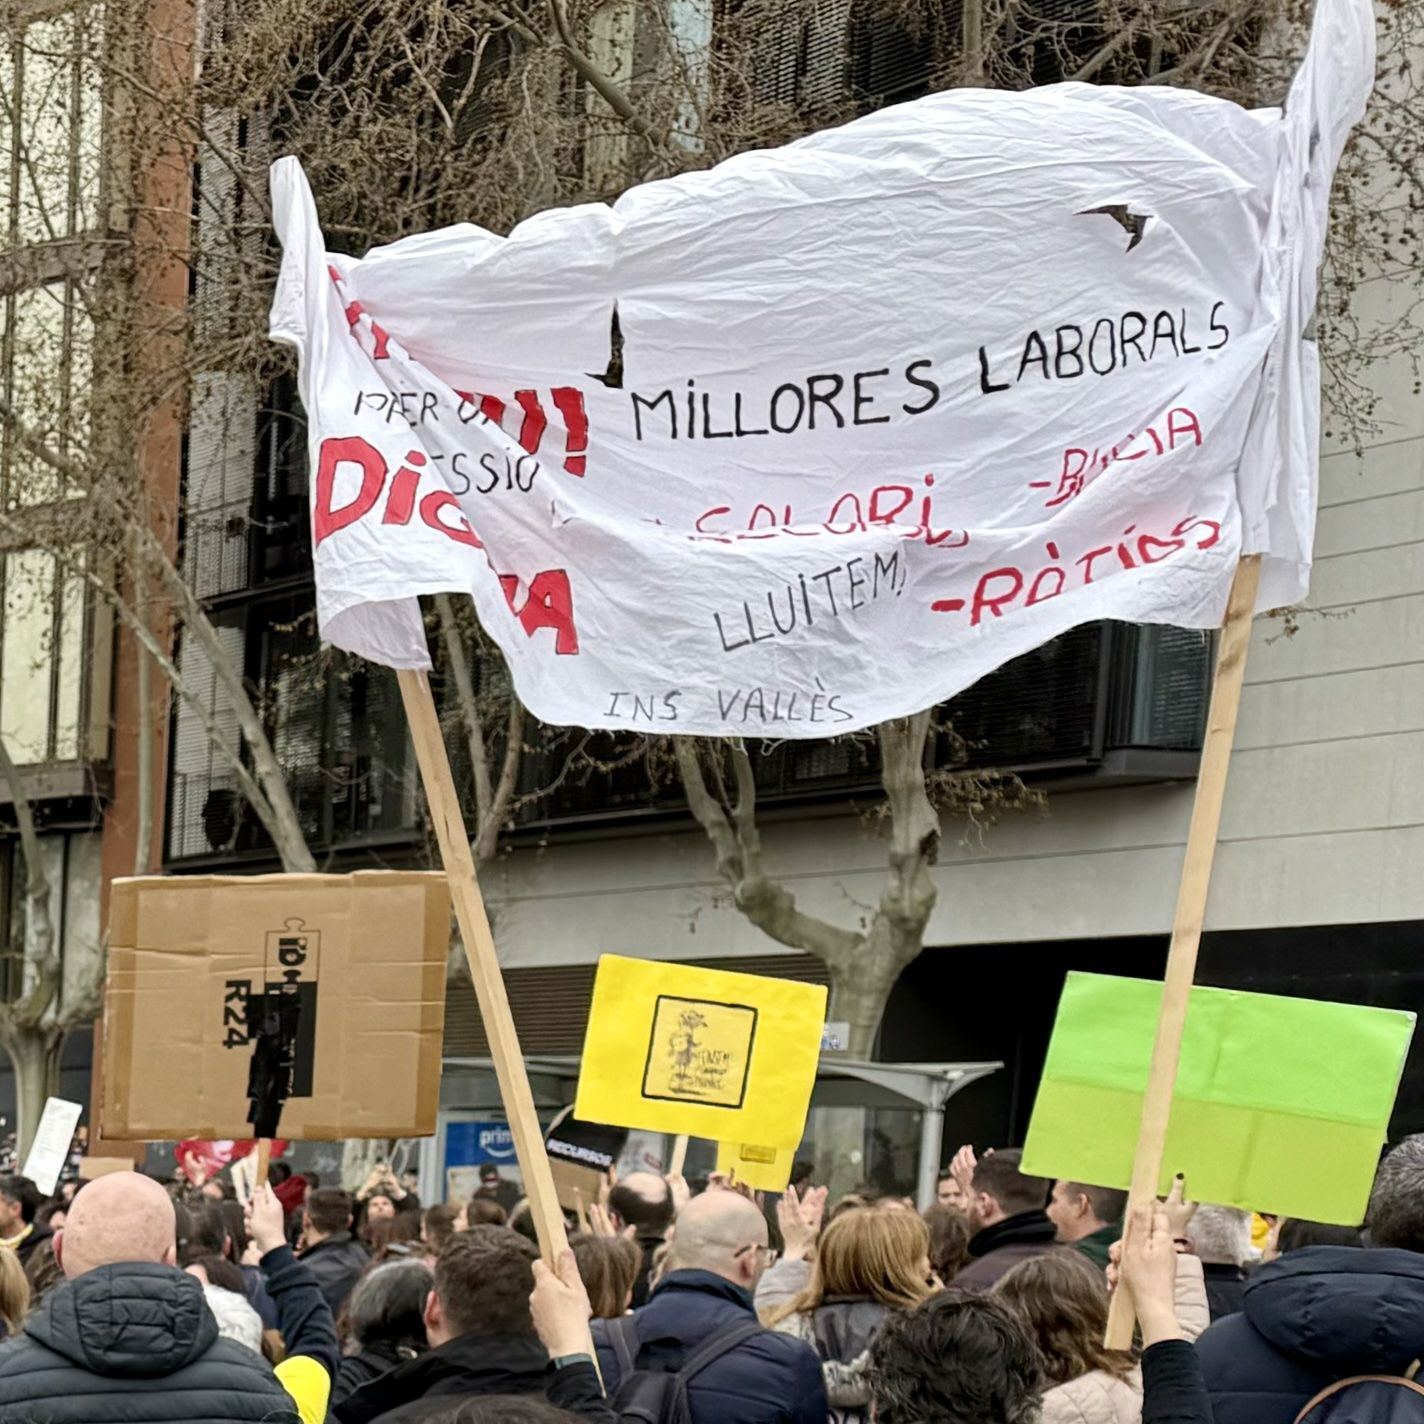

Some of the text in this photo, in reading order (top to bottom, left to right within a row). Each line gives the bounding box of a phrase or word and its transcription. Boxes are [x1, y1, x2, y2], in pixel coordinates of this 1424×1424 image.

[978, 301, 1230, 395] LABORALS
[603, 676, 854, 723] INS VALLÈS
[223, 979, 252, 1049] R24
